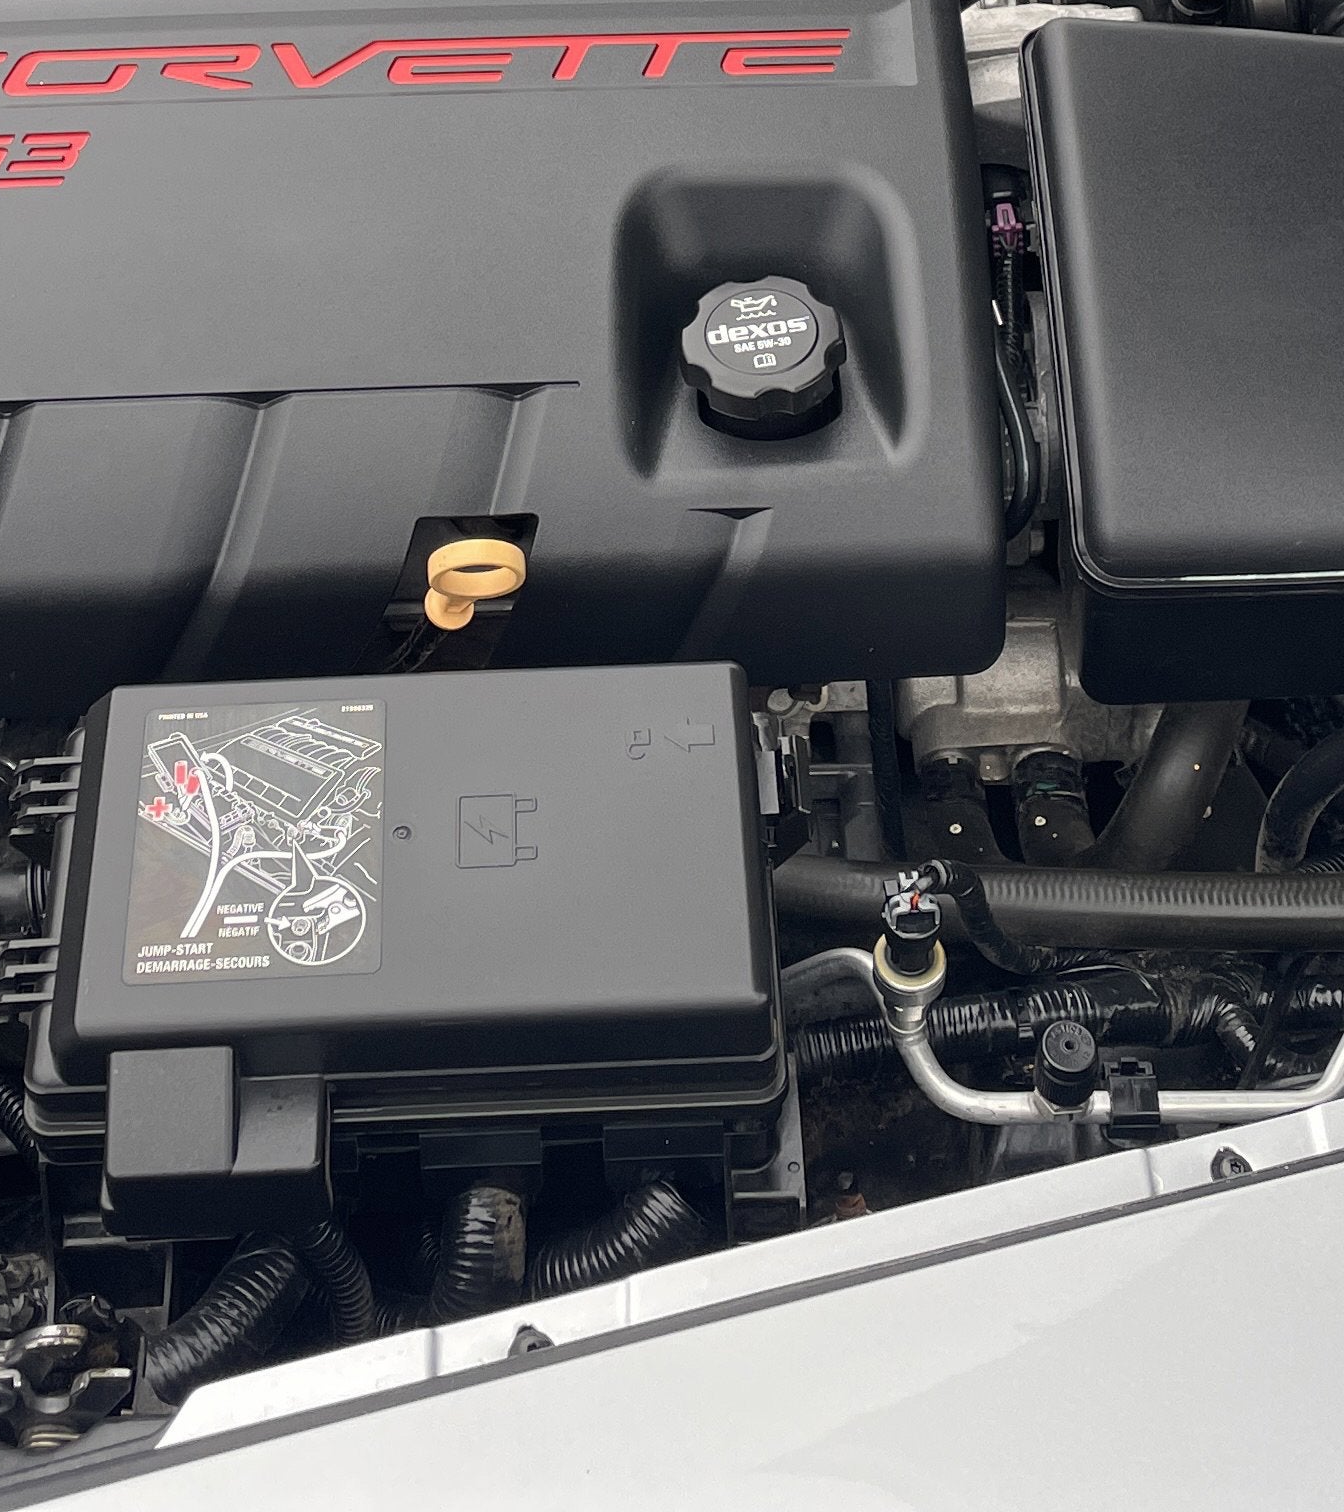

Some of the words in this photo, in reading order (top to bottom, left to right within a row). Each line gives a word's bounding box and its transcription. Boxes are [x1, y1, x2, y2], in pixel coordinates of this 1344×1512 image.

[707, 317, 809, 345] dexos
[734, 342, 756, 353] SAE
[756, 337, 791, 350] 5W-30
[216, 903, 265, 914] NEGATIVE
[137, 942, 214, 958] JUMP-START
[136, 956, 271, 974] DEMARRAGE-SECOURS
